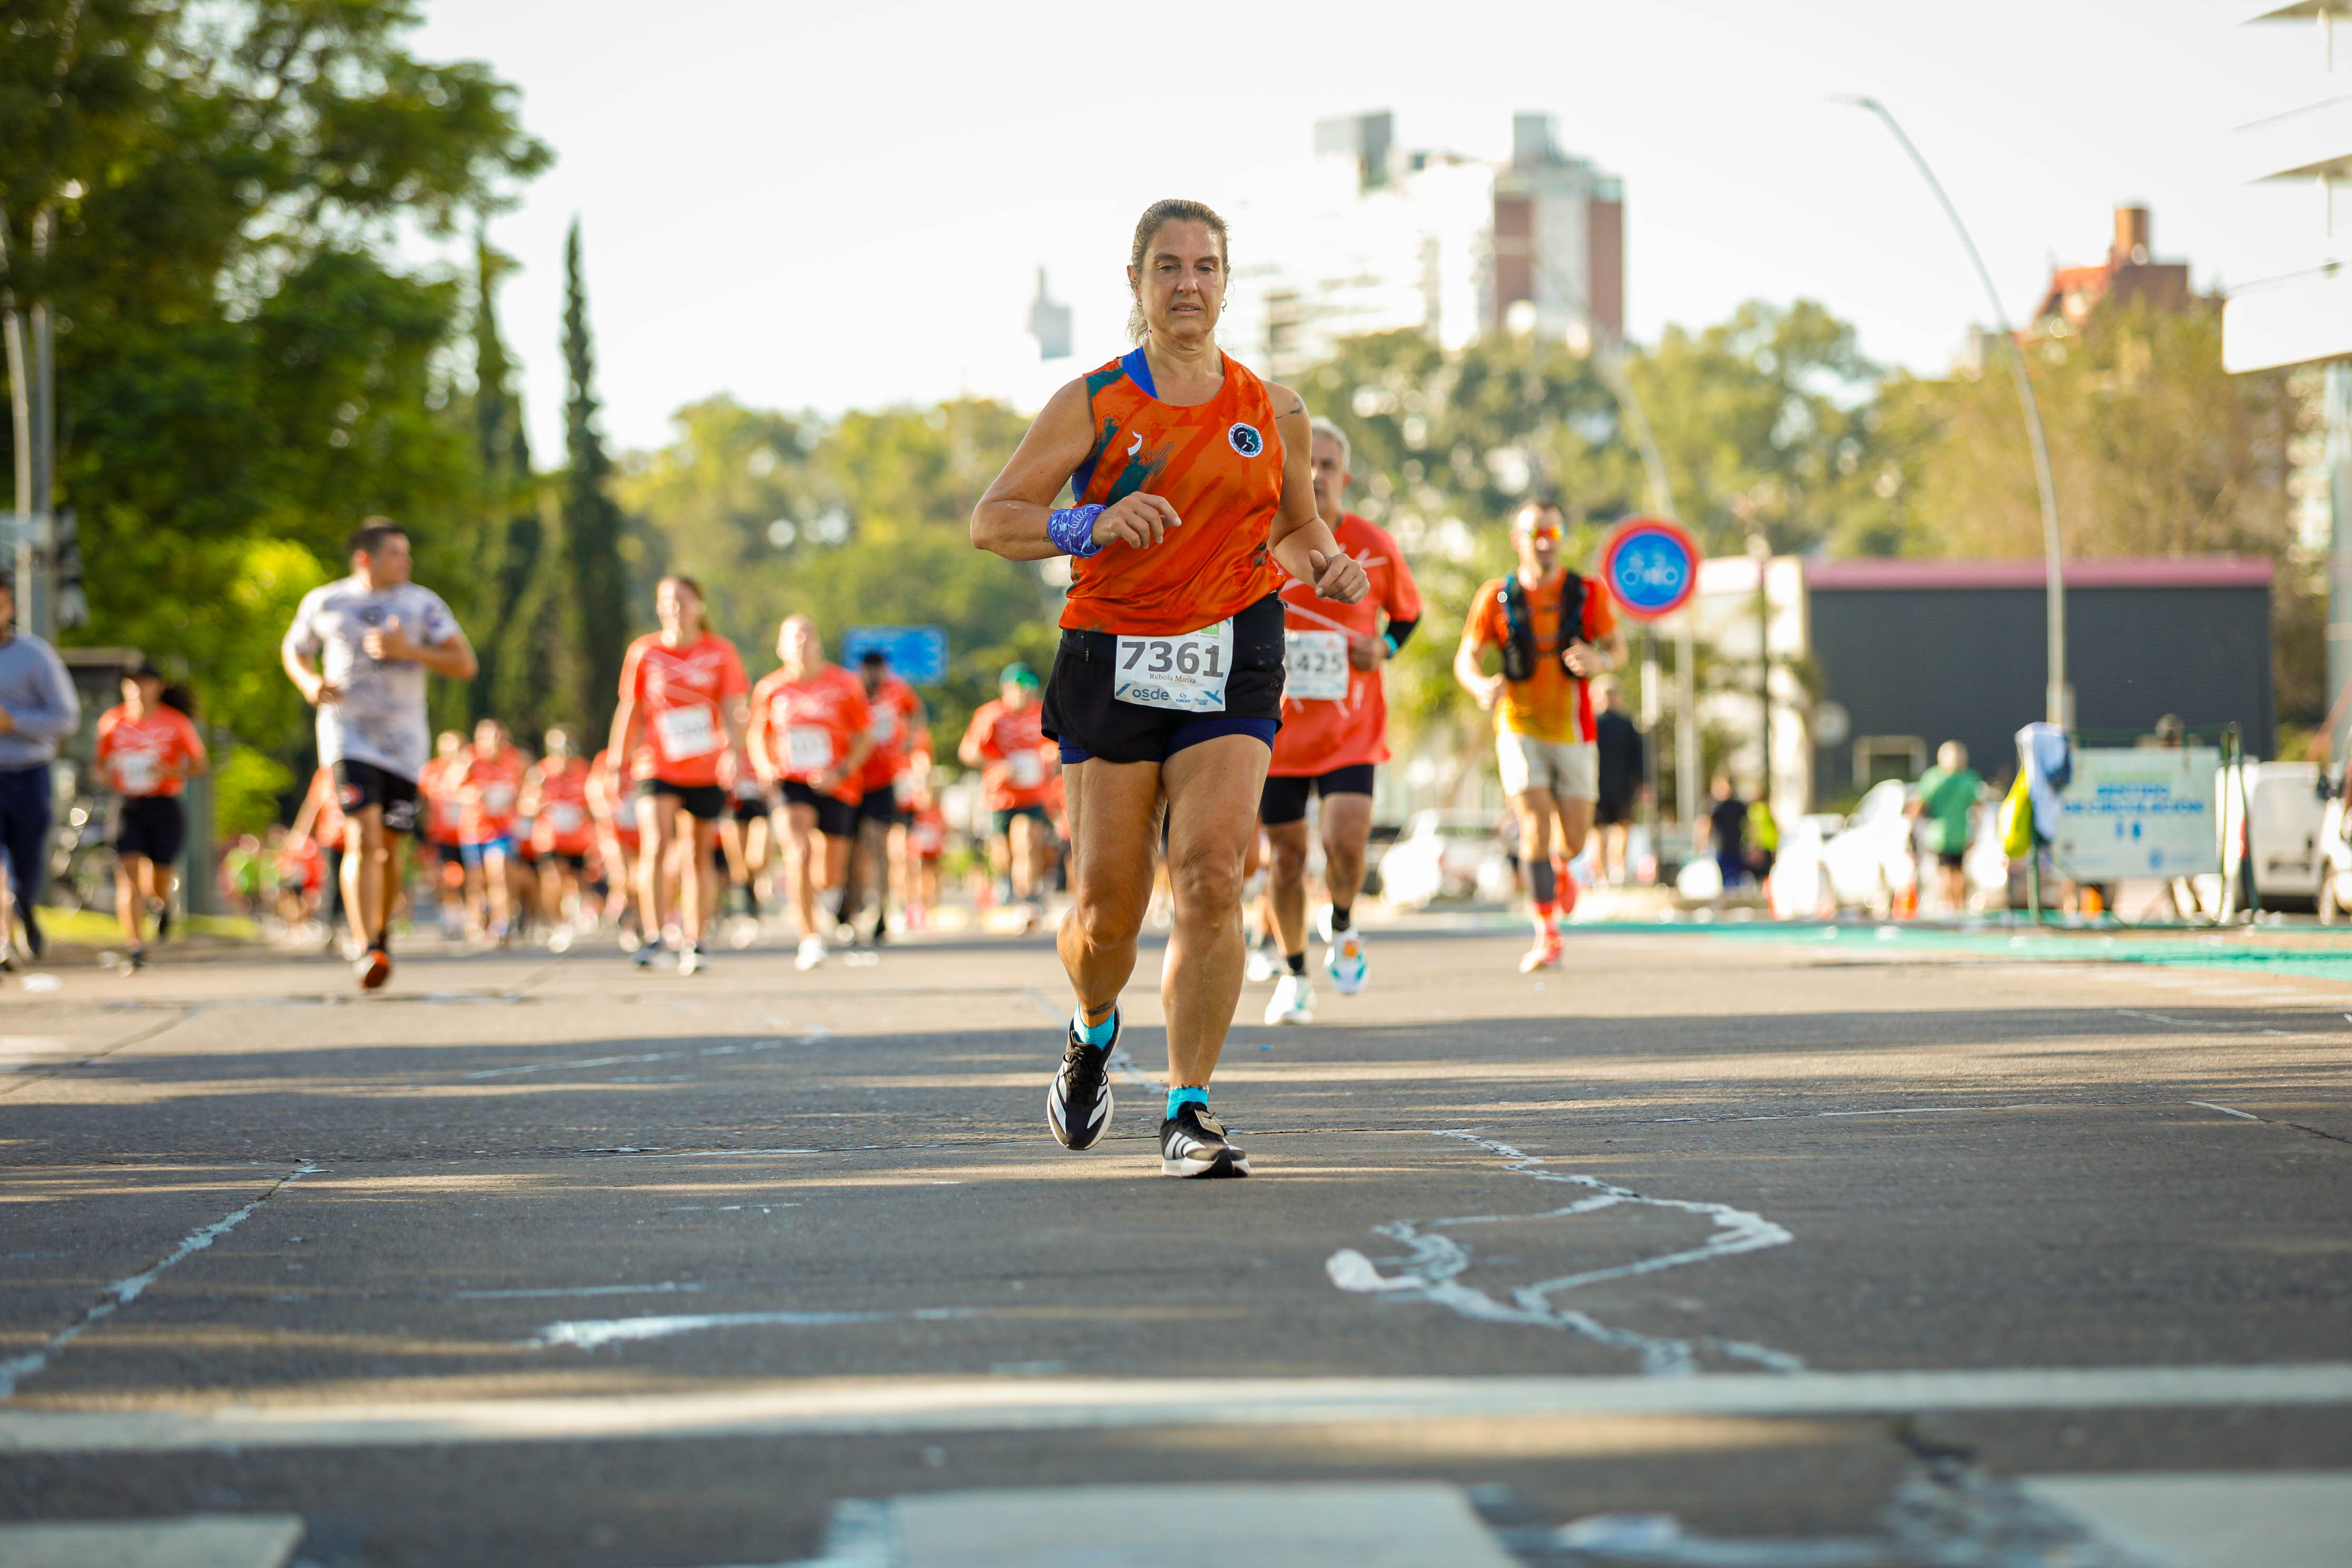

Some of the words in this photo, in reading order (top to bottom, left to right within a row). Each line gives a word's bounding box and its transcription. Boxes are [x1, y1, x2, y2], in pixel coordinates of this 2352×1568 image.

[1121, 641, 1224, 678] 7361
[1175, 675, 1196, 683] Marisa
[1132, 688, 1170, 701] osde
